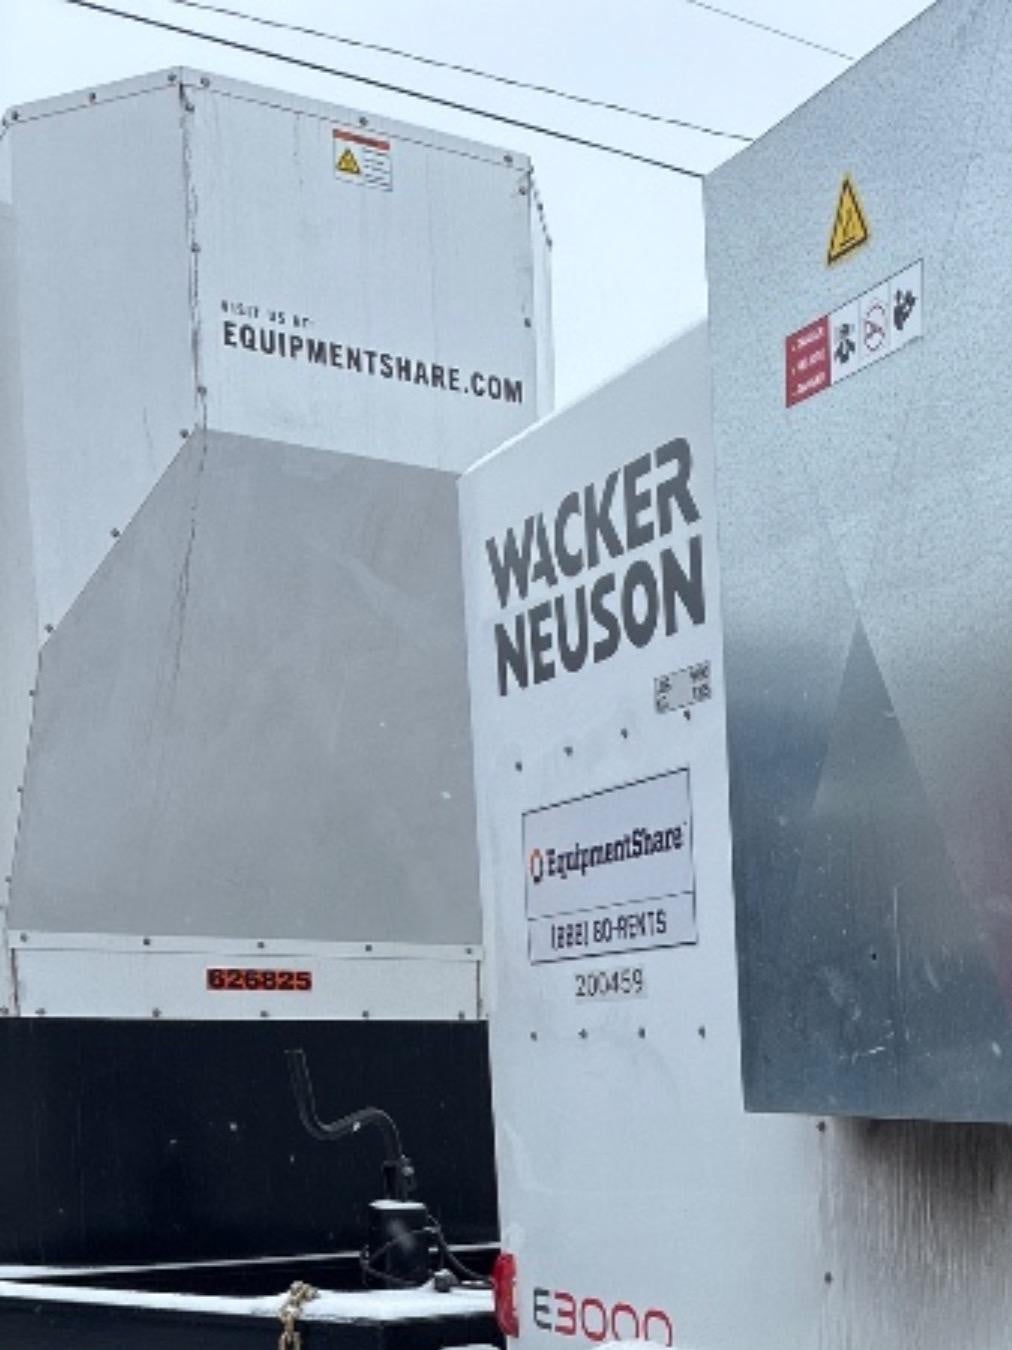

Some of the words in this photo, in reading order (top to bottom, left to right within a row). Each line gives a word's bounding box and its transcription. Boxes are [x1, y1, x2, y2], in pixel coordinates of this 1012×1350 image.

[223, 320, 524, 404] EQUIPMENTSHARE.COM
[485, 437, 702, 609] WACKER
[494, 534, 706, 697] NEUSON
[546, 824, 684, 880] EquipmentShare
[206, 968, 312, 991] 626825
[574, 968, 644, 997] 200459
[533, 1287, 673, 1347] E3000
